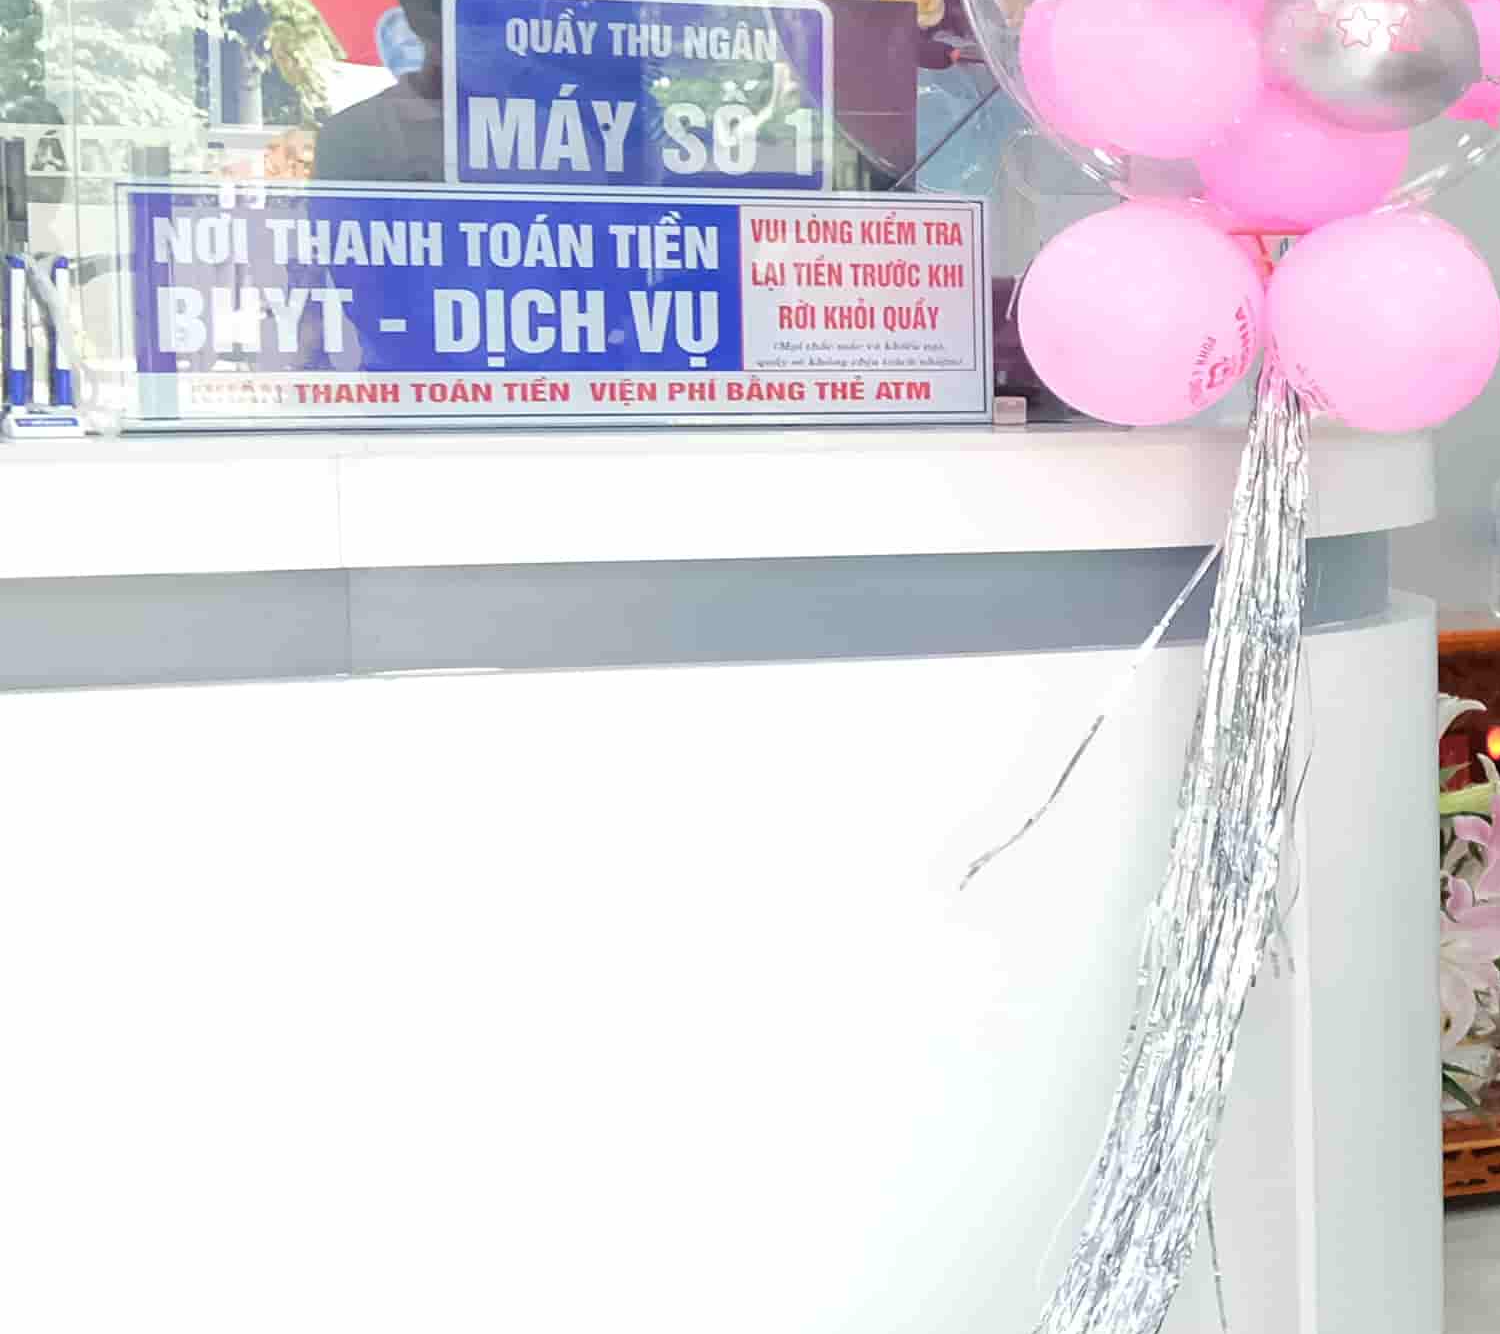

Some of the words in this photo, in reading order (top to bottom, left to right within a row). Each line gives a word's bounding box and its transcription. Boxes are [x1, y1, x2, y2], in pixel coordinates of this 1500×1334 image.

[505, 7, 598, 58] QUẦY
[608, 21, 674, 58] THU
[683, 21, 778, 61] NGÂN
[467, 83, 637, 173] MÁY
[662, 79, 758, 176] SỐ
[786, 107, 815, 177] 1
[152, 211, 249, 265] NƠI
[266, 219, 443, 268] THANH
[458, 213, 593, 269] TOÁN
[609, 210, 720, 270] TIỀN
[751, 218, 787, 244] VUI
[794, 214, 854, 245] LÒNG
[861, 211, 917, 245] KIỂM
[923, 220, 963, 247] TRA
[751, 261, 786, 291] LẠI
[849, 257, 921, 288] TRƯỚC
[928, 263, 965, 288] KHI
[156, 287, 353, 354] BHYT
[434, 288, 606, 369] DỊCH
[628, 289, 721, 369] VỤ
[778, 299, 817, 331] RỜI
[823, 298, 875, 331] KHỎI
[294, 383, 401, 404] THANH
[409, 378, 494, 404] TOÁN
[502, 376, 571, 404] TIỀN
[590, 378, 658, 407] VIỆN
[667, 376, 716, 403] PHÍ
[727, 375, 806, 403] BẰNG
[815, 373, 866, 402] THẺ
[876, 380, 932, 402] ATM
